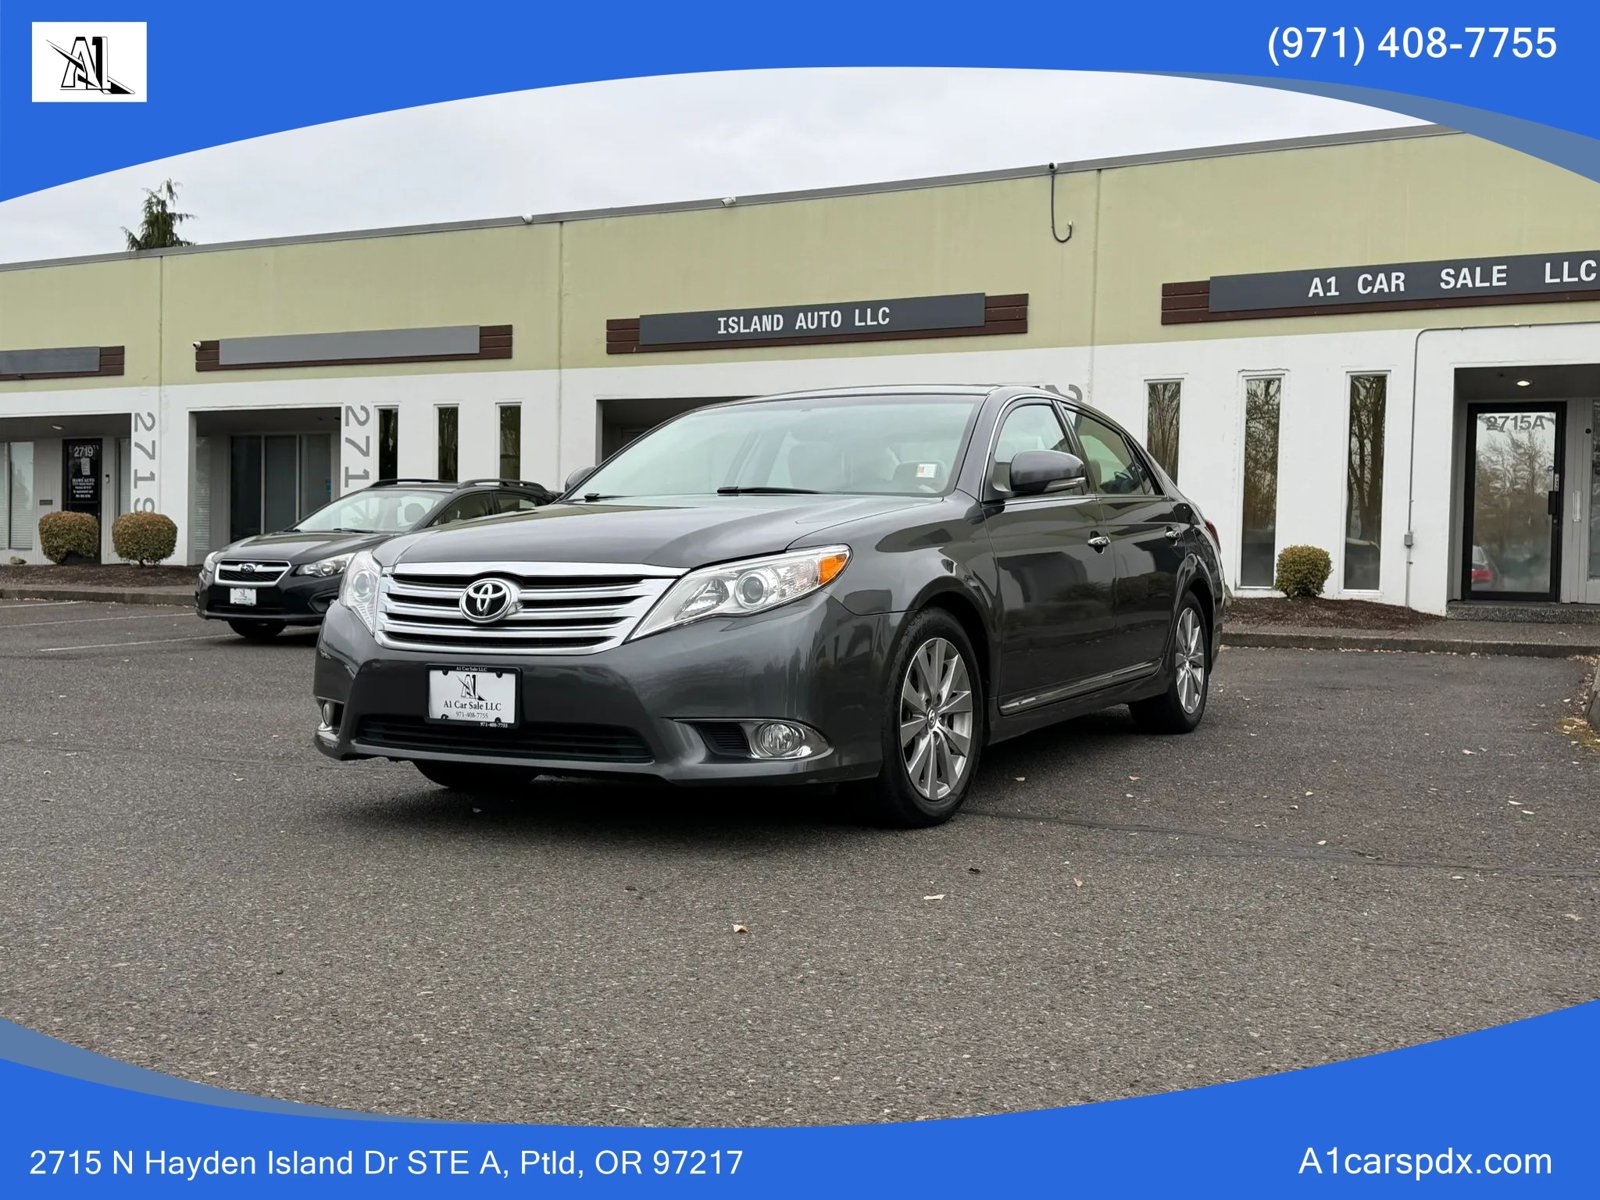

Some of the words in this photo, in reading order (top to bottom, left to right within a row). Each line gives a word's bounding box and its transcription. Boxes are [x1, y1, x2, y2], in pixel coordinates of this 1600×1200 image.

[1307, 276, 1341, 298] A1
[1356, 271, 1406, 295] CAR
[1439, 264, 1508, 290] SALE
[1544, 259, 1598, 284] LLC
[717, 313, 785, 335] ISLAND
[795, 310, 843, 331] AUTO
[854, 306, 891, 327] LLC
[1485, 415, 1546, 431] 2715A
[74, 446, 93, 457] 2719
[344, 404, 371, 489] 271
[133, 411, 157, 514] 2719
[453, 700, 468, 709] Car
[468, 701, 484, 710] Sale
[485, 702, 502, 711] LLC
